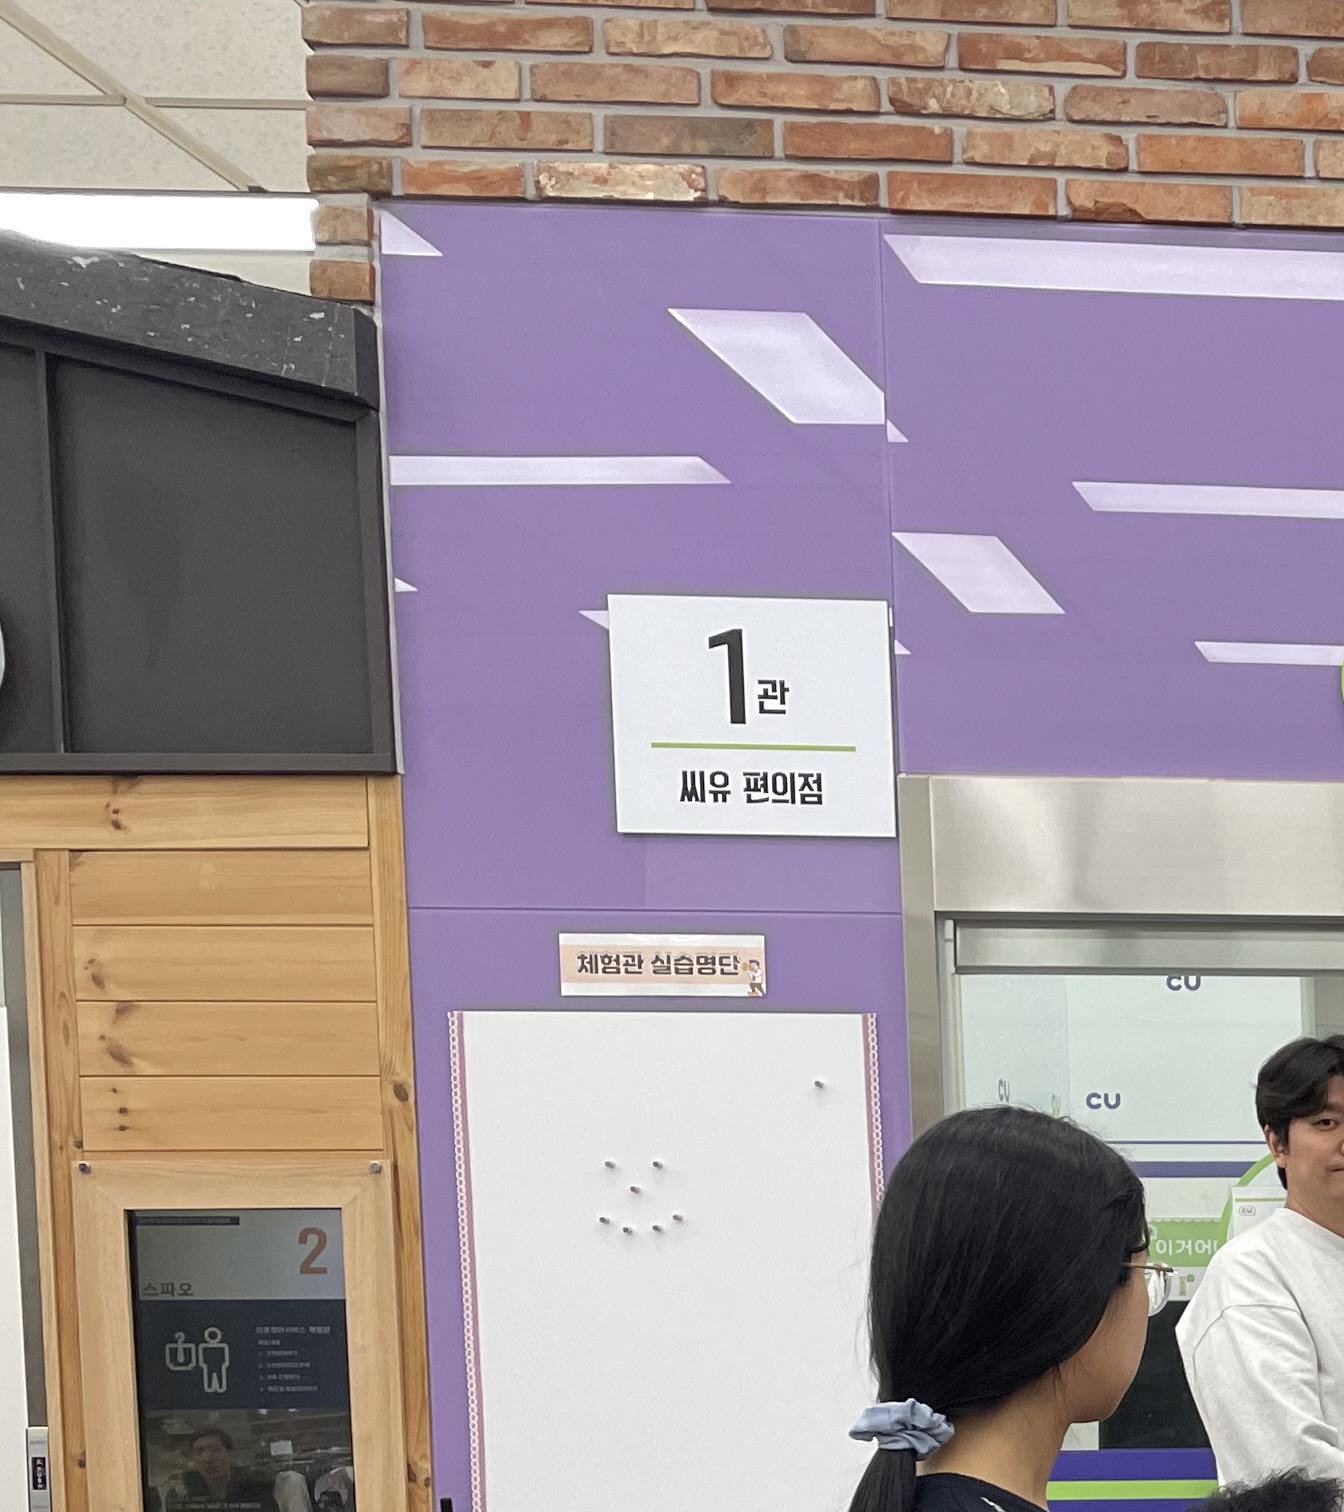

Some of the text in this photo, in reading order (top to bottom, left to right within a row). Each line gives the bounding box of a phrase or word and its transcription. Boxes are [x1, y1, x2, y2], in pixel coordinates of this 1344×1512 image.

[680, 769, 823, 805] 씨유 편의점
[576, 952, 741, 977] 체험관 실습명단
[1166, 975, 1201, 991] CU
[1086, 1092, 1121, 1109] CU
[298, 1227, 328, 1274] 2
[142, 1282, 194, 1297] 스파오
